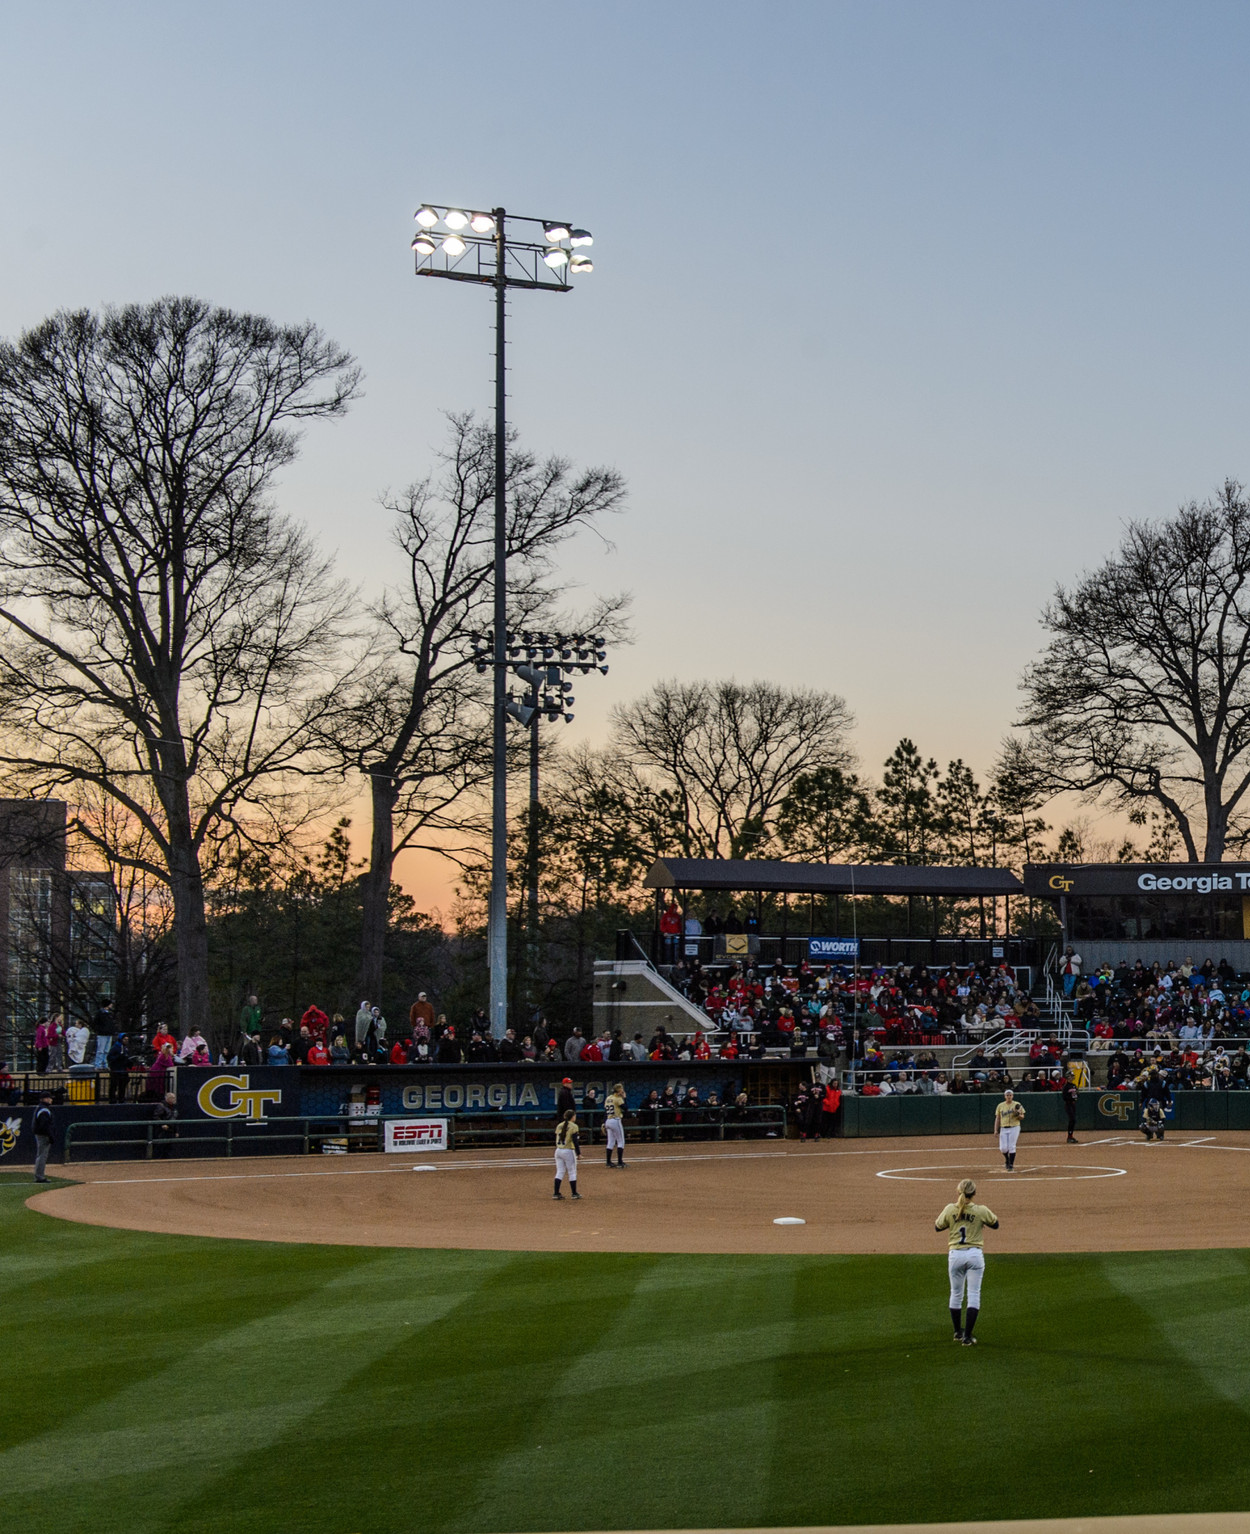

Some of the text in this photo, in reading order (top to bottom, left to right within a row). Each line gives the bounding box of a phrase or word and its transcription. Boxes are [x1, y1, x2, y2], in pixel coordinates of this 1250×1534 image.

[1048, 875, 1074, 892] GT
[1137, 873, 1233, 894] Georgia
[821, 941, 858, 951] WORTH
[197, 1074, 281, 1125] GT
[402, 1082, 540, 1109] GEORGIA
[1098, 1093, 1134, 1121] GT
[393, 1125, 442, 1139] ESPN
[959, 1226, 967, 1245] 1
